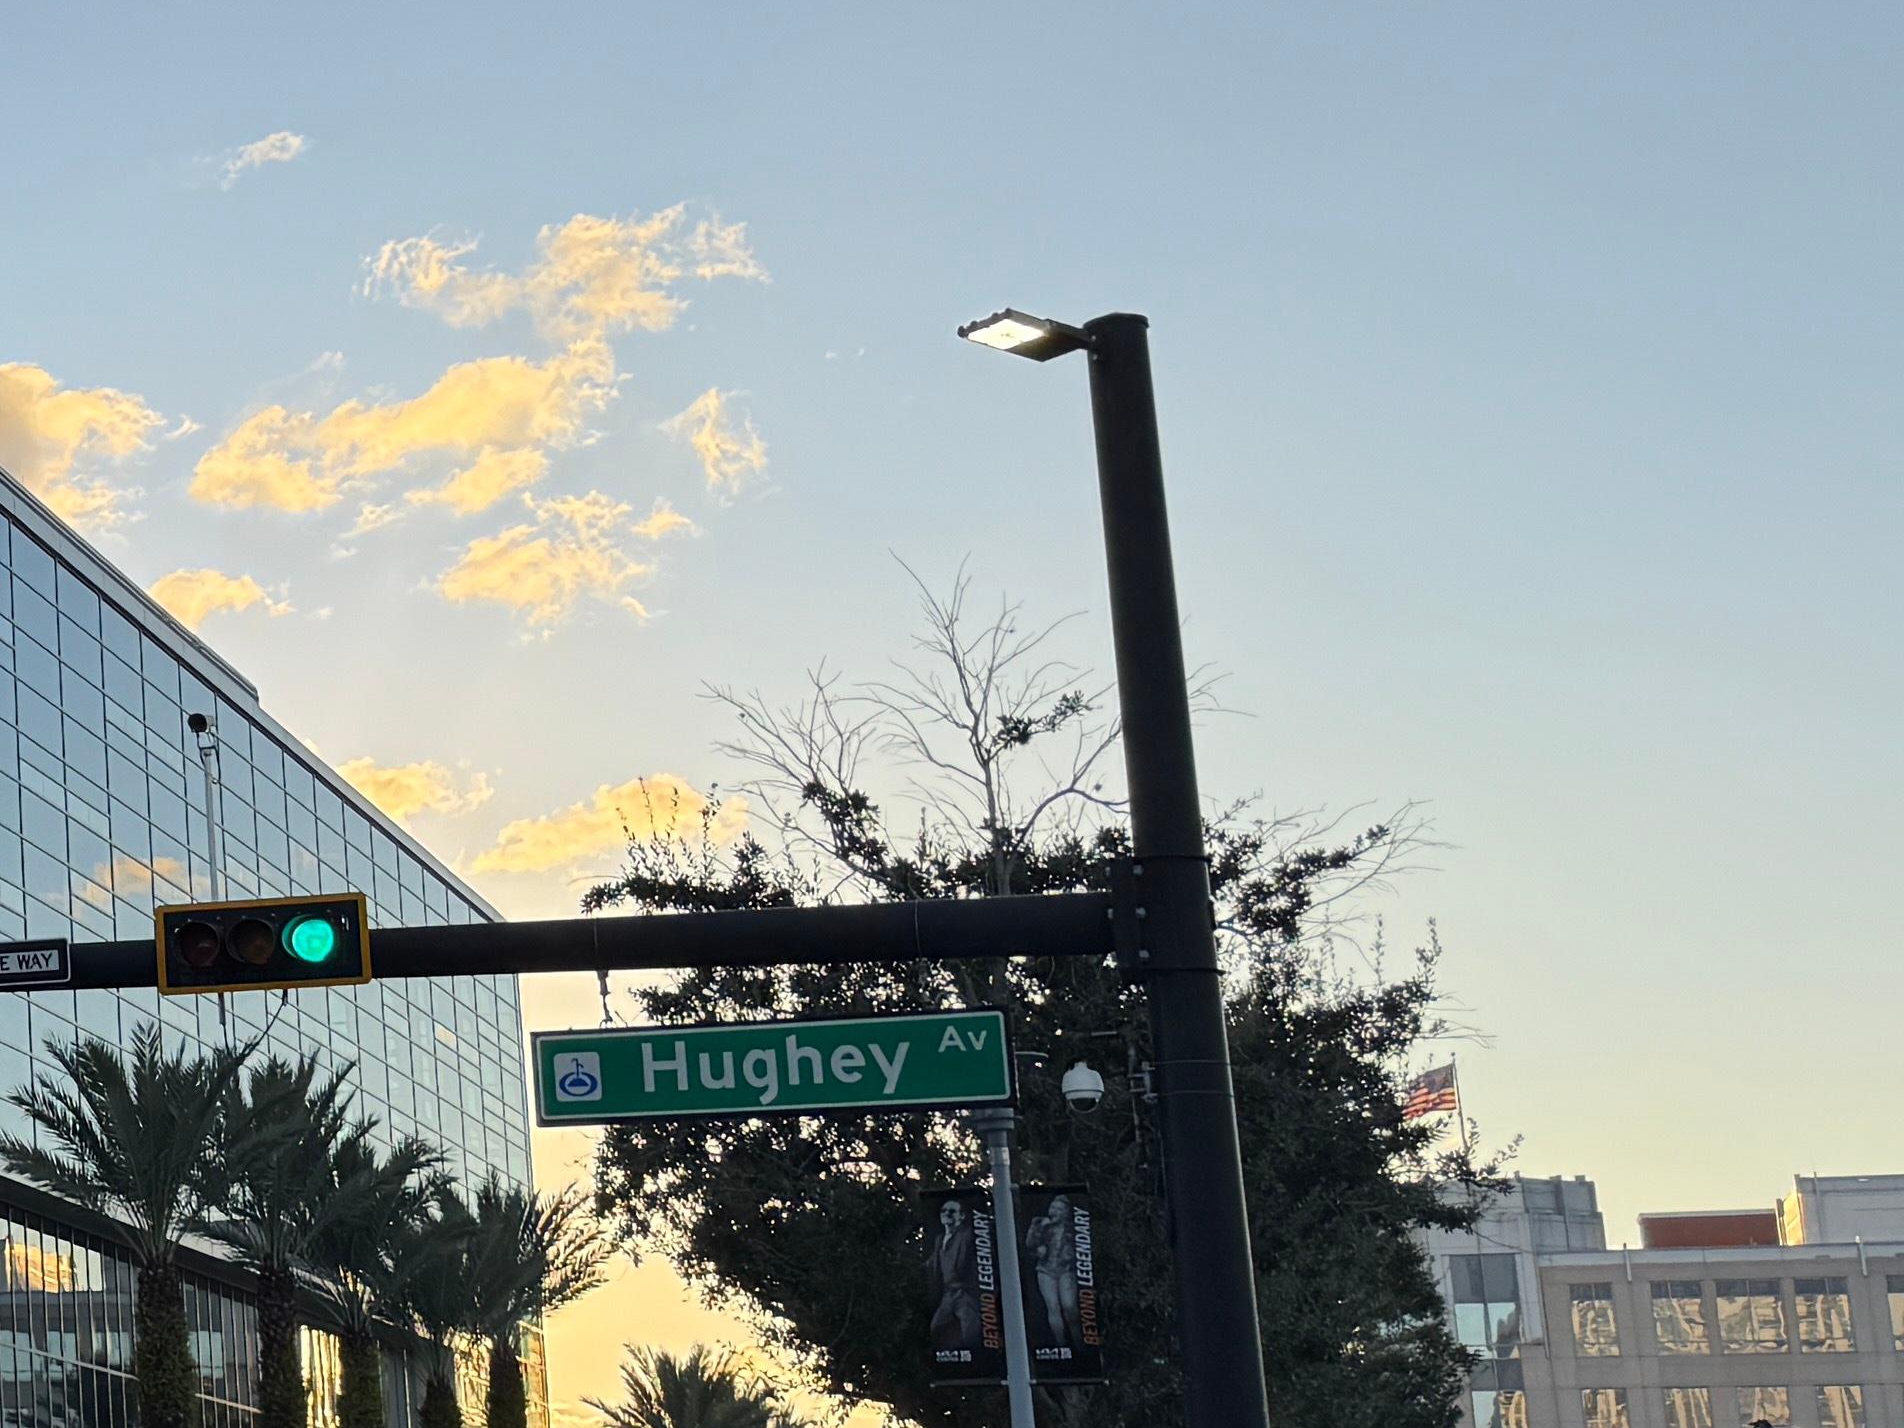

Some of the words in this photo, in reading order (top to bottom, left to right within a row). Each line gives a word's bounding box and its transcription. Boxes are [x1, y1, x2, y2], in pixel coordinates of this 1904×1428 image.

[17, 952, 53, 969] WAY
[641, 1035, 910, 1106] Hughey
[938, 1025, 989, 1053] Av
[973, 1209, 995, 1291] LEGENDARY
[1072, 1206, 1095, 1287] LEGENDARY
[980, 1293, 1000, 1349] BEYOND
